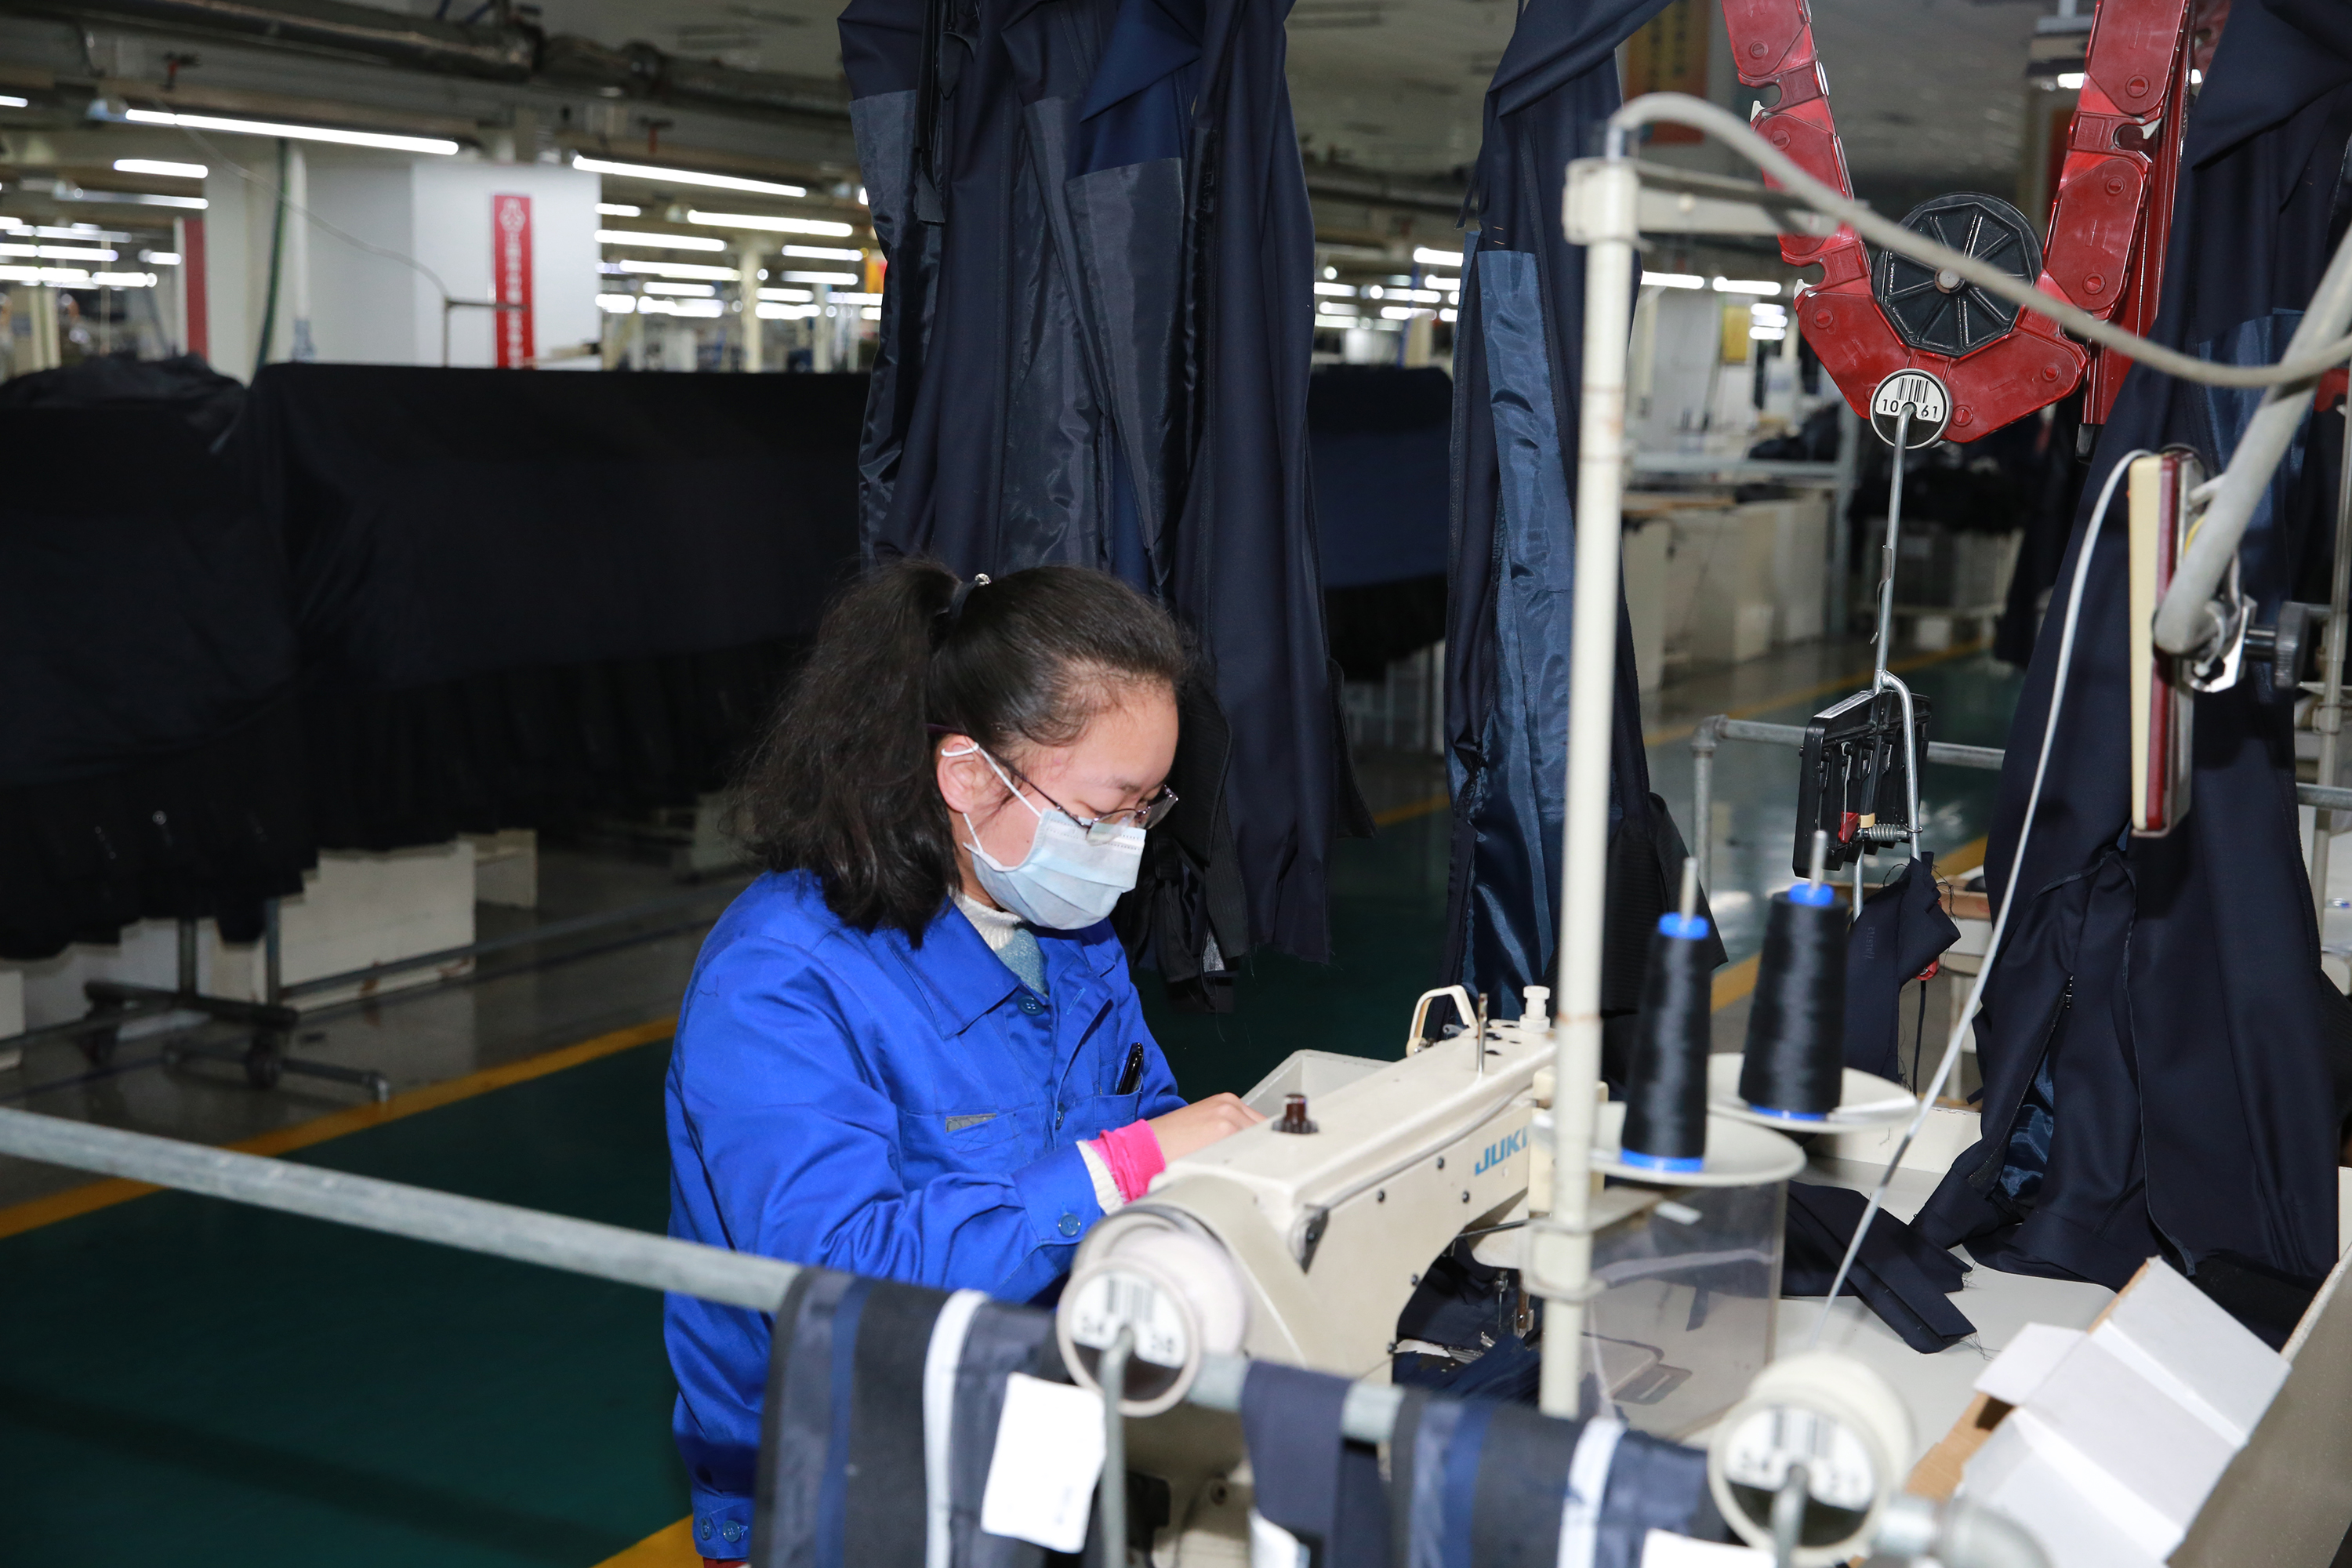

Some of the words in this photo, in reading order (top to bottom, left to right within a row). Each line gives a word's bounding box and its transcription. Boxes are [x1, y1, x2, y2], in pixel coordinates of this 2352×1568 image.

[1882, 398, 1899, 412] 10
[1921, 405, 1938, 419] 61
[1475, 1125, 1529, 1176] JUKI
